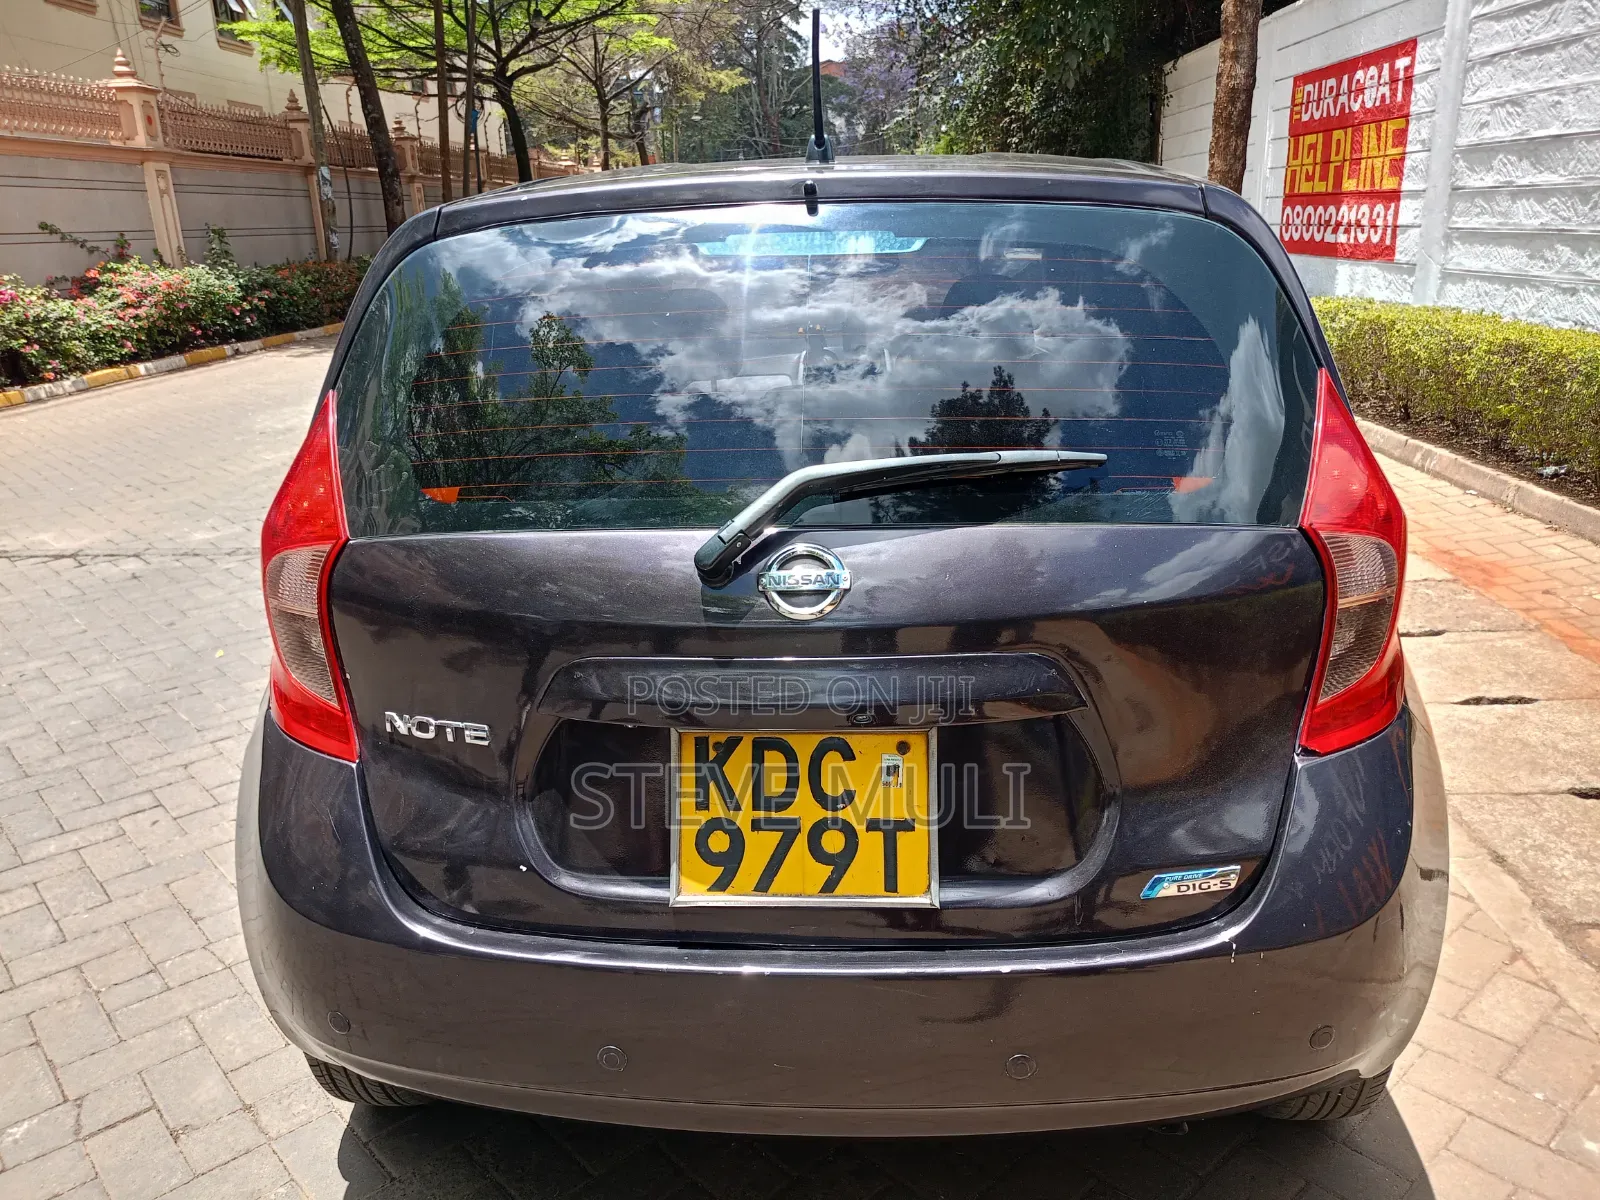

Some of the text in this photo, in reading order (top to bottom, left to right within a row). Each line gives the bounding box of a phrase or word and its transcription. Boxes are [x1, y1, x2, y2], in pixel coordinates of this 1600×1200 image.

[1301, 56, 1411, 121] DURACOAT
[1286, 119, 1408, 193] HELPLINE
[1281, 202, 1395, 246] 0800221331
[768, 573, 840, 586] NISSAN
[384, 711, 491, 746] NOTE
[693, 736, 857, 813] KDC
[694, 816, 916, 894] 979T
[1183, 872, 1203, 880] DRIVE
[1176, 880, 1232, 893] DIG-S
